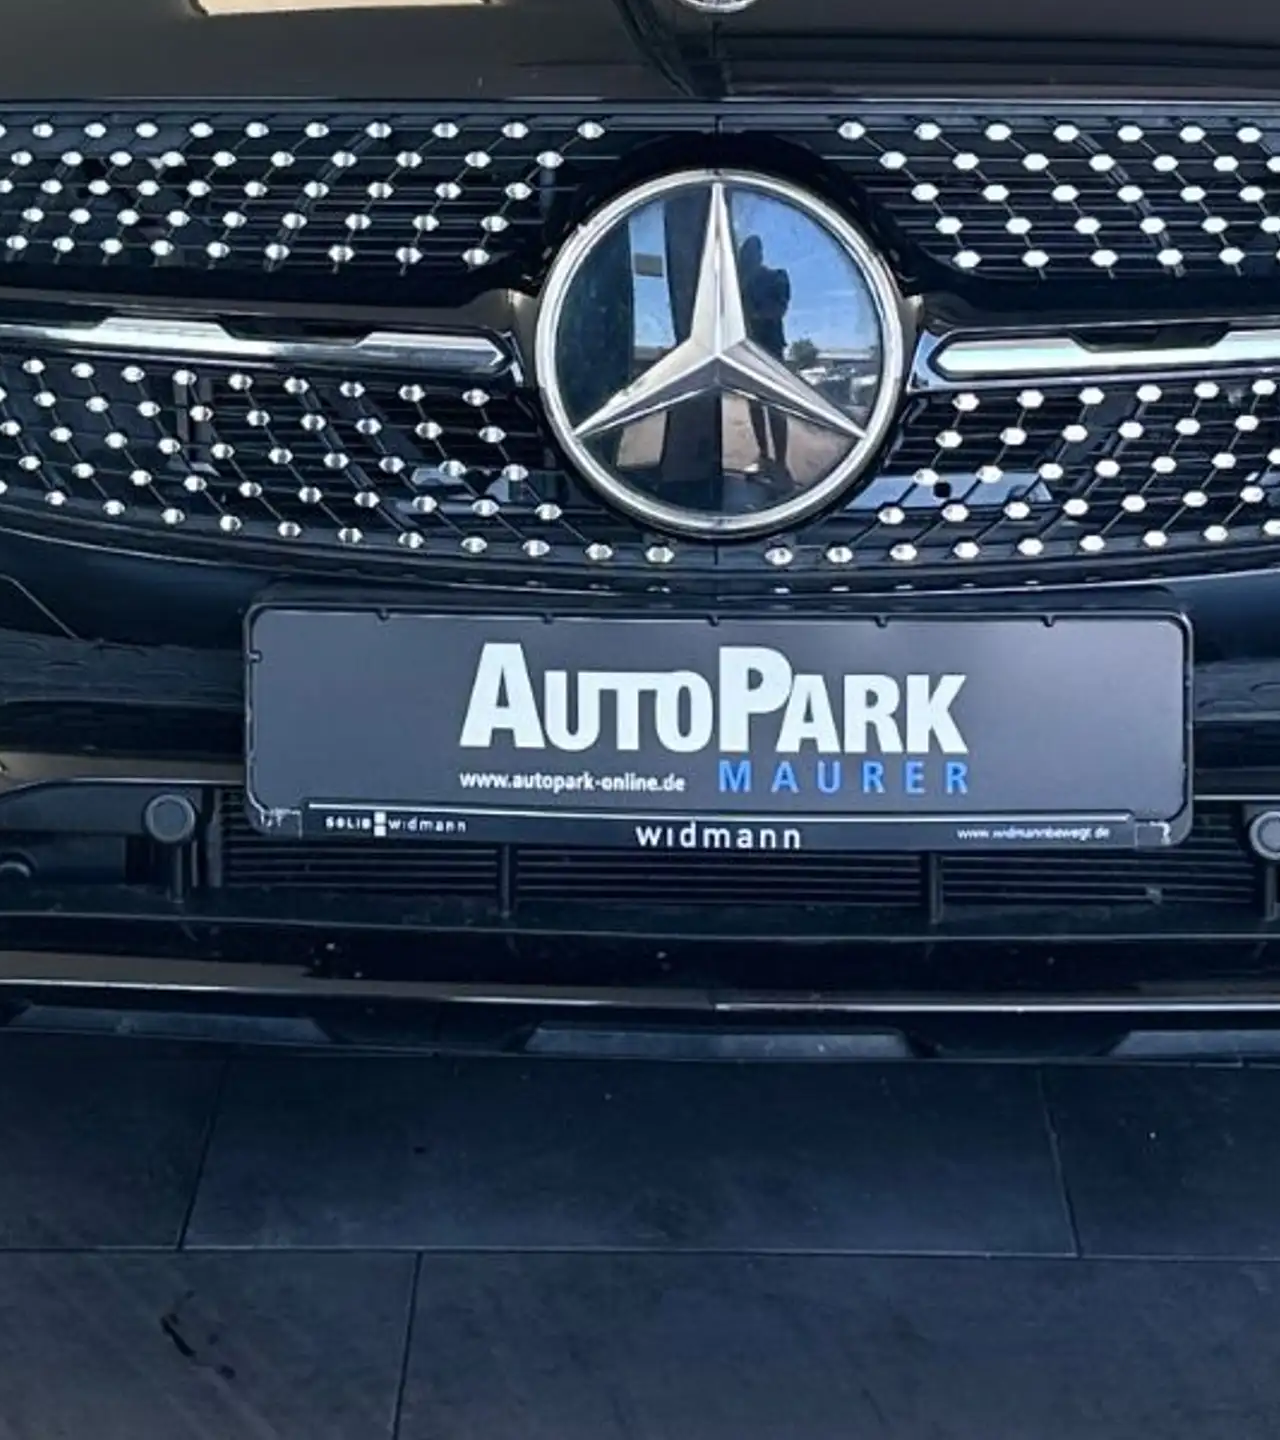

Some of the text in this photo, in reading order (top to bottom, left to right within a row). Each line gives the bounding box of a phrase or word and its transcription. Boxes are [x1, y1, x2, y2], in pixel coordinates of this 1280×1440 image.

[459, 771, 685, 794] www.autopark-online.de
[719, 760, 968, 794] MAURER
[635, 821, 801, 850] widmann
